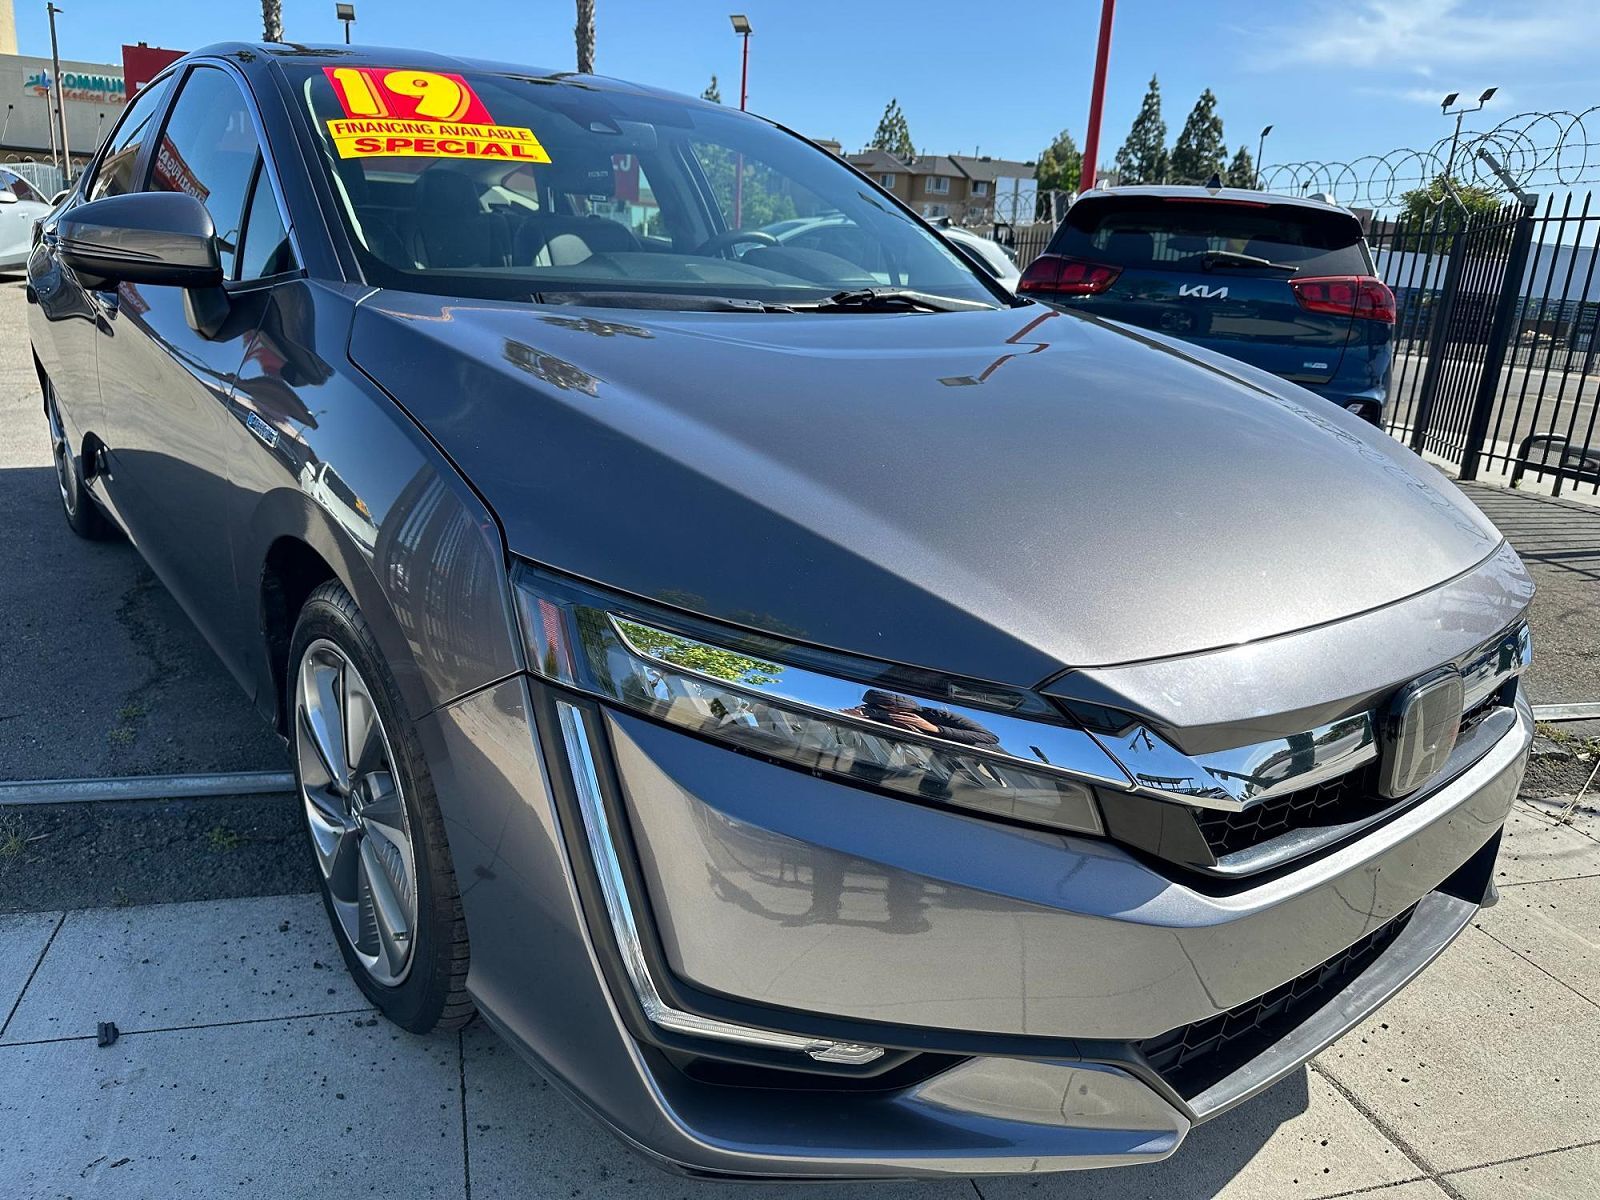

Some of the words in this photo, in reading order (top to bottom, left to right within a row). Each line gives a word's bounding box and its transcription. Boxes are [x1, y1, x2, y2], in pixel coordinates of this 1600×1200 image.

[61, 72, 125, 94] OMMUN
[334, 68, 471, 121] 19
[334, 122, 434, 135] FINANCING
[439, 124, 532, 142] AVAILABLE
[353, 137, 536, 160] SPECIAL
